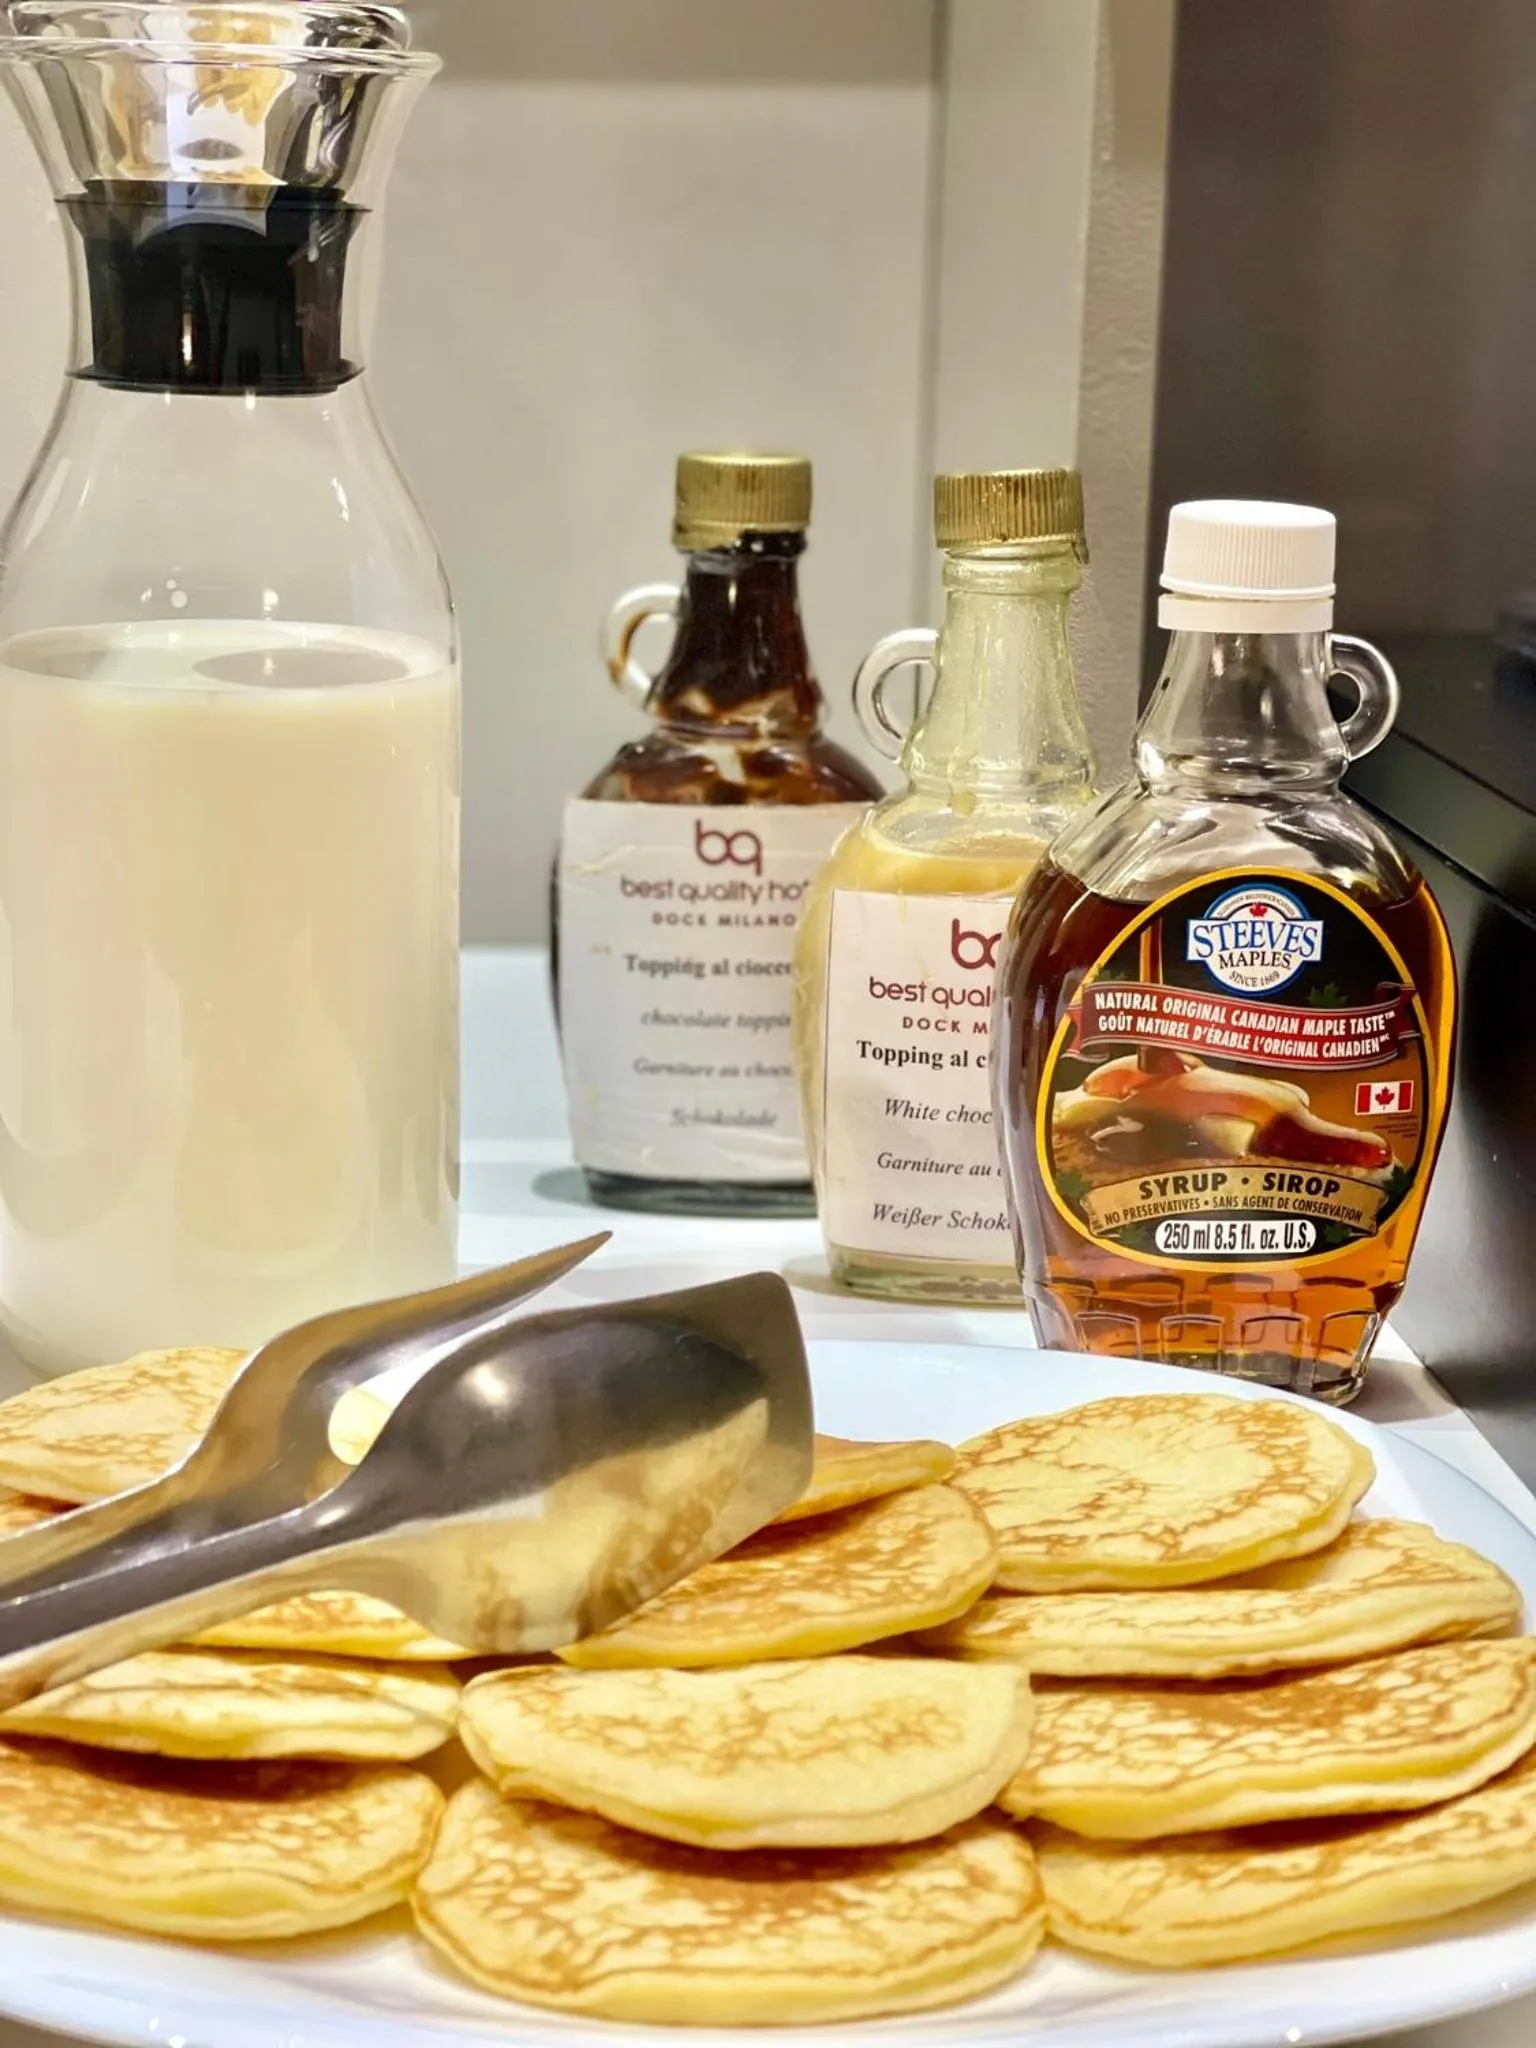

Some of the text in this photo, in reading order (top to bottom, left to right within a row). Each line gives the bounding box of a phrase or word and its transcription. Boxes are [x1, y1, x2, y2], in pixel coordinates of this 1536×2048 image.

[695, 818, 762, 876] bq
[620, 874, 674, 899] best
[678, 880, 762, 905] quality
[652, 912, 797, 926] DOCK MILANO
[1192, 920, 1318, 958] STEEVES
[624, 954, 706, 978] Topping
[711, 958, 730, 975] al
[1218, 951, 1292, 970] MAPLES
[869, 976, 927, 1003] best
[1229, 970, 1258, 987] SINCE
[640, 1008, 732, 1027] chocolate
[902, 1016, 961, 1033] DOCK
[1095, 992, 1158, 1012] NATURAL
[1162, 997, 1226, 1025] ORIGINAL
[1231, 1009, 1300, 1034] CANADIAN
[1302, 1018, 1346, 1036] MAPLE
[1098, 1011, 1133, 1032] GOÛT
[1135, 1016, 1189, 1040] NATUREL
[1253, 1035, 1319, 1057] L'ORIGINAL
[633, 1056, 715, 1077] Garniture
[719, 1065, 740, 1077] au
[856, 1040, 944, 1071] Topping
[950, 1050, 969, 1068] al
[885, 1098, 941, 1121] White
[877, 1151, 964, 1175] Garniture
[969, 1164, 992, 1177] au
[1139, 1172, 1341, 1200] SYRUP SIROP
[872, 1203, 943, 1229] Weißer
[1104, 1195, 1363, 1225] NO PRESERVATIVES SANS AGENT DE CONSERVATION
[1163, 1222, 1311, 1250] 250 ml 8.5 fl. oz. U.S.
